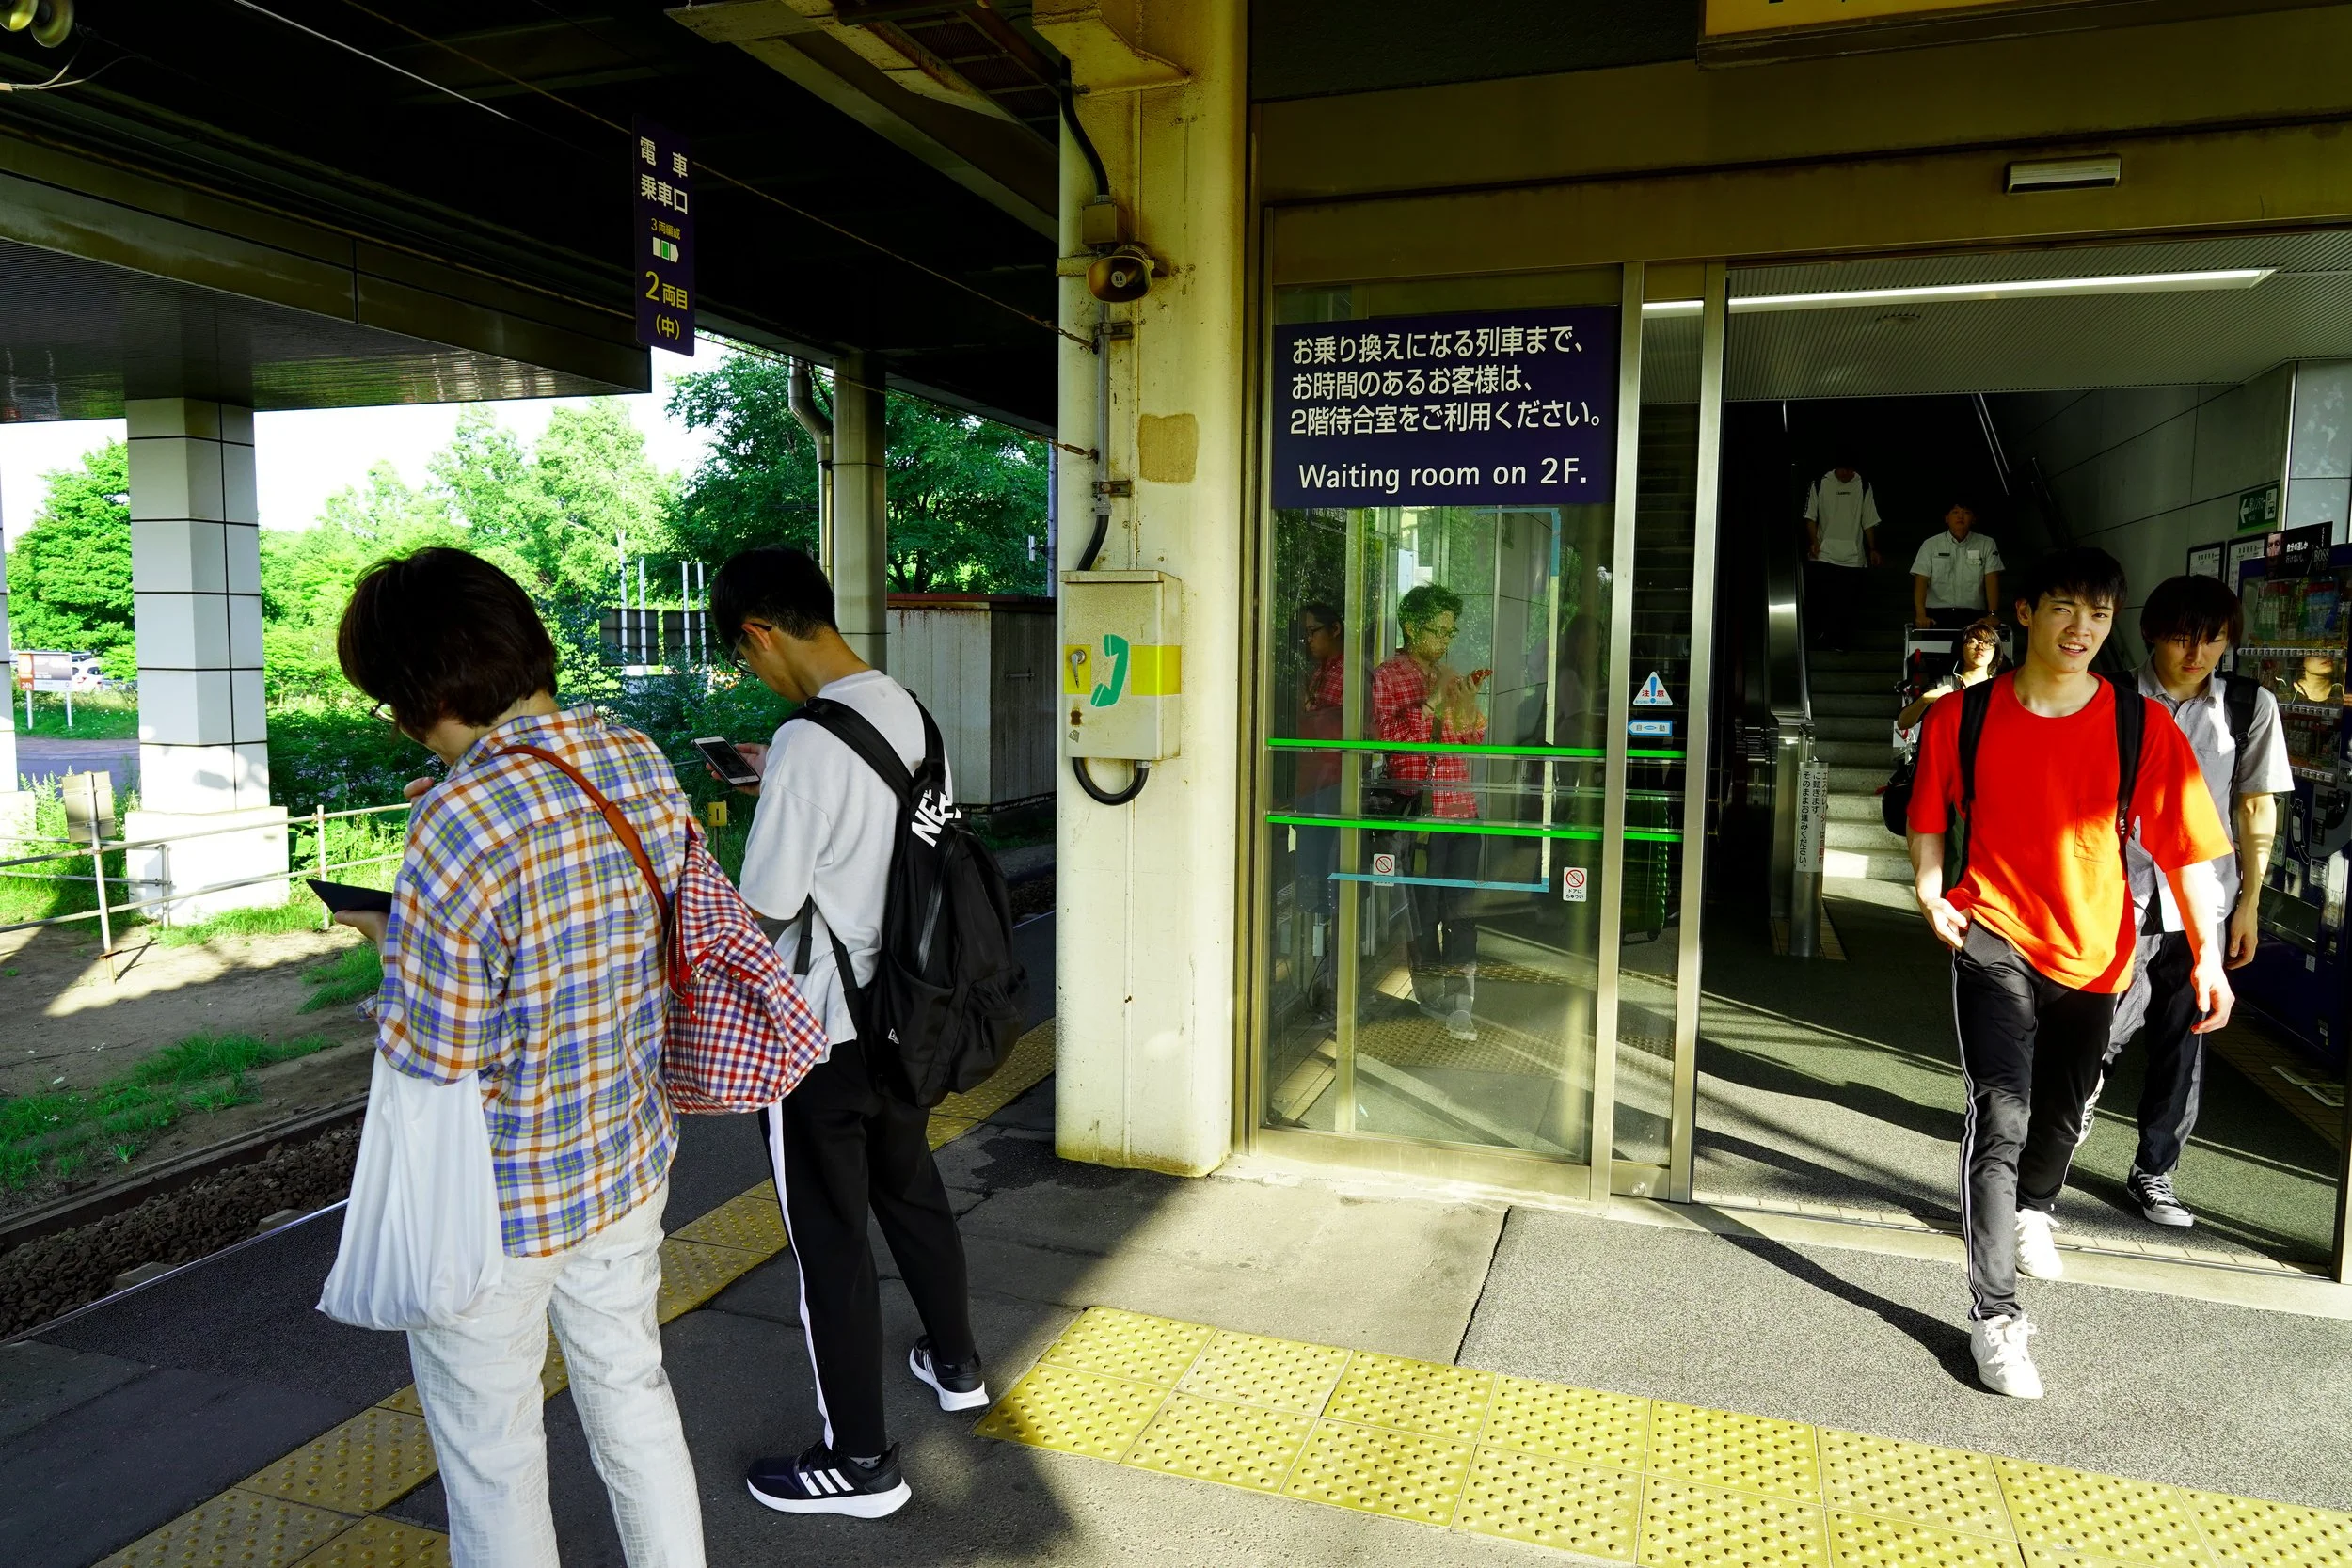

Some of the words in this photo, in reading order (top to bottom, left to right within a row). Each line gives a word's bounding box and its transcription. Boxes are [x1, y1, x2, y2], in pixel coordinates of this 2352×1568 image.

[641, 173, 688, 214] 乗車口
[650, 217, 680, 240] 3両編成
[645, 271, 688, 310] 2両目
[1293, 325, 1583, 365] お乗り換えになる列車まで、
[1292, 364, 1532, 401] お時間のあるお客様は、
[1291, 400, 1599, 436] 2階待合室をご利用ください。
[1299, 464, 1399, 494] Waiting
[1411, 467, 1480, 485] room
[1493, 466, 1526, 485] on
[1540, 458, 1587, 484] 2F.
[2314, 548, 2329, 562] BOSS
[1799, 771, 1811, 867] そのままお進みください。
